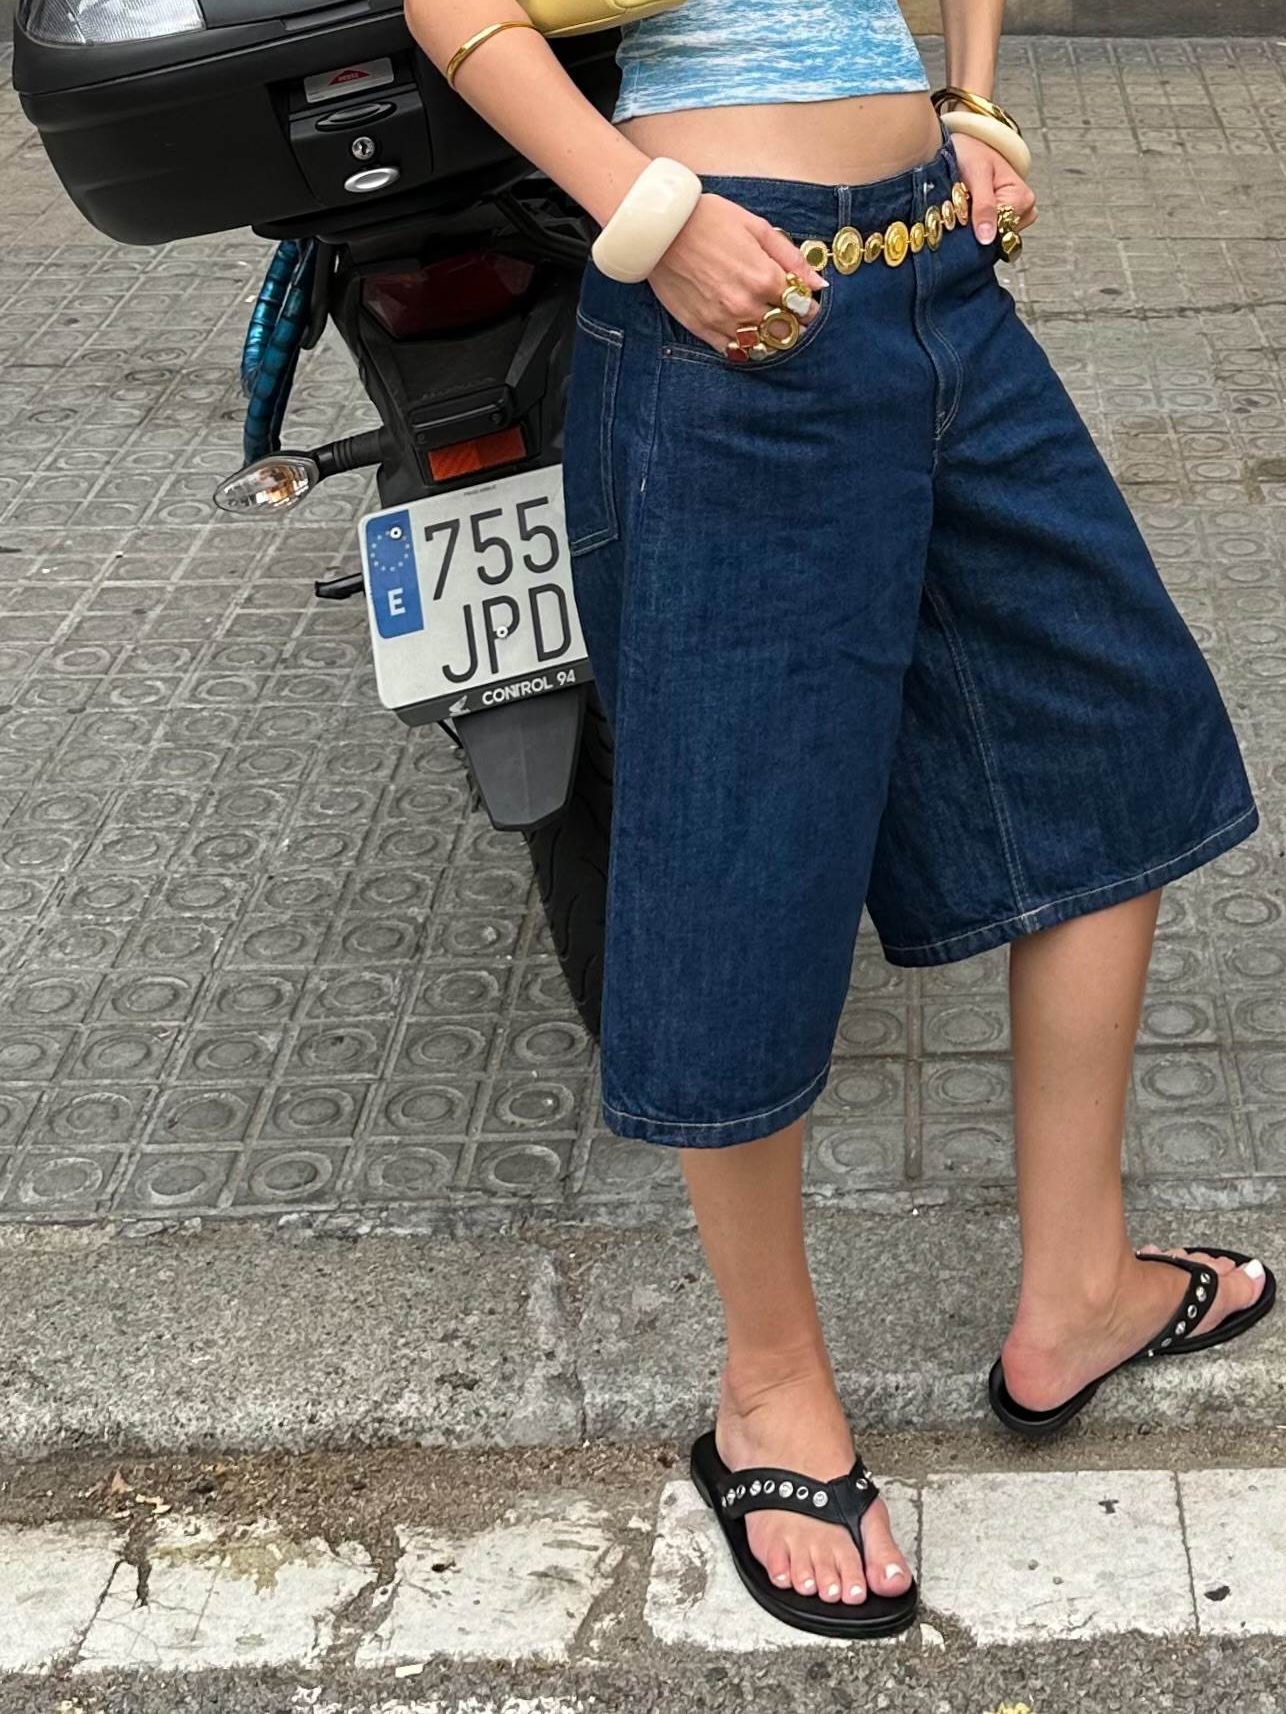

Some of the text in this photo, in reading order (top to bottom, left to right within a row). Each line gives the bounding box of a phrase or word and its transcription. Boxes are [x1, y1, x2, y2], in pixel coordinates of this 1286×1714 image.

[387, 587, 406, 617] E
[442, 583, 573, 684] JPD
[481, 670, 576, 706] CONTROL 94
